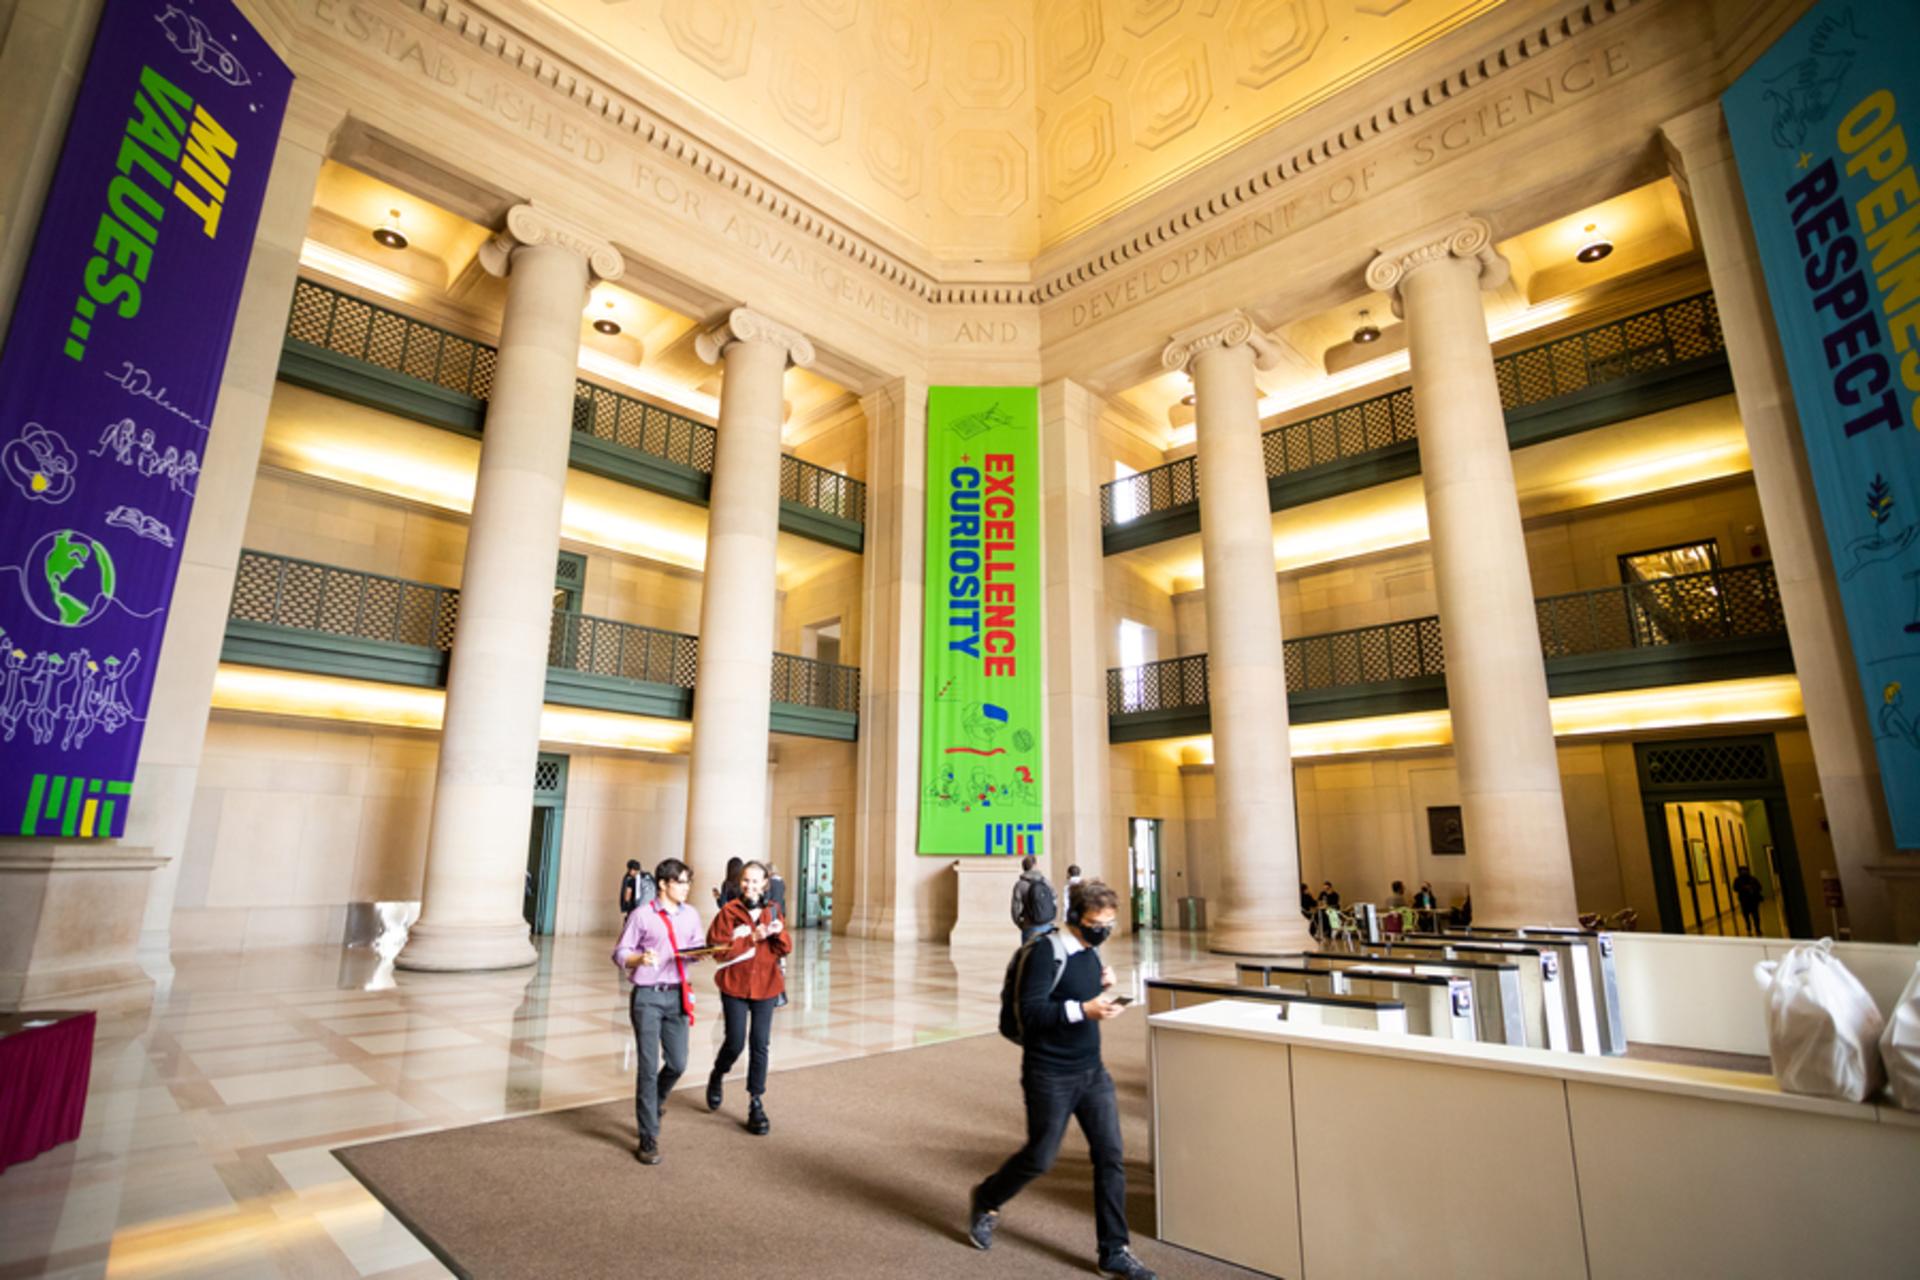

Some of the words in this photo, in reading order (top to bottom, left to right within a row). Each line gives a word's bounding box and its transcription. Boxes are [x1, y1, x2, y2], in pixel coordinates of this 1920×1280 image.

[64, 65, 194, 361] VALUES...
[174, 104, 238, 239] MIT
[314, 0, 605, 165] ESTABLISHED
[634, 162, 702, 221] FOR
[954, 320, 1018, 344] AND
[1071, 204, 1298, 328] DEVELOPMENT
[1328, 161, 1377, 204] OF
[1413, 40, 1630, 166] SCIENCE
[1785, 157, 1904, 438] RESPECT
[1837, 89, 1920, 433] OPENNE
[948, 466, 981, 659] CURIOSITY
[984, 453, 1016, 677] EXCELLENCE
